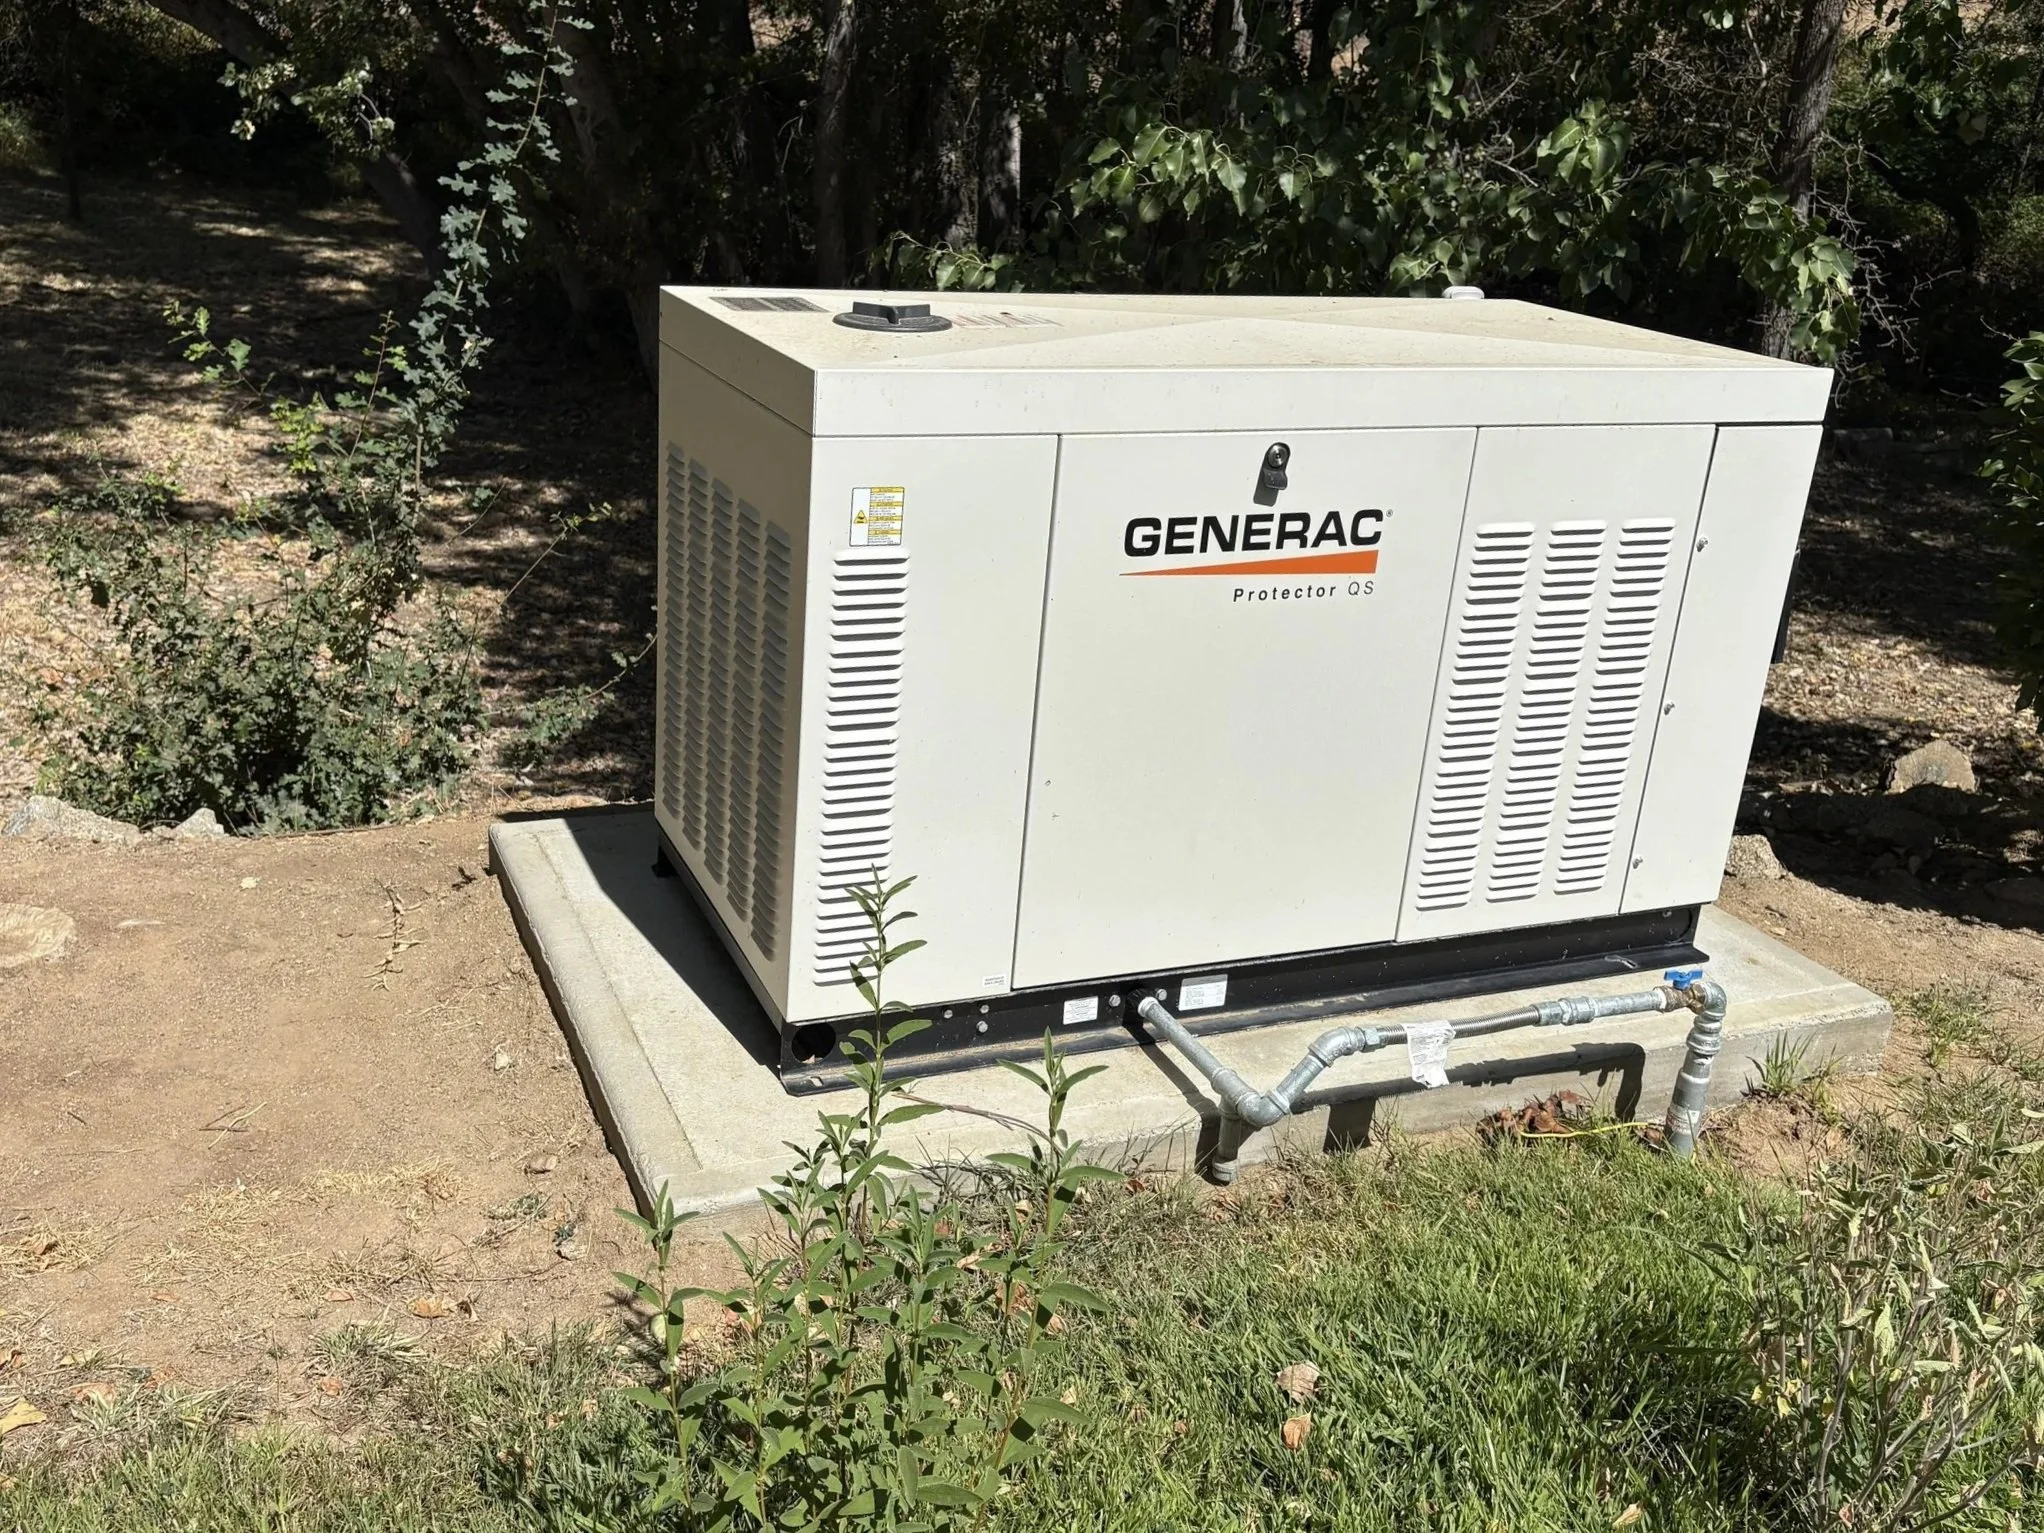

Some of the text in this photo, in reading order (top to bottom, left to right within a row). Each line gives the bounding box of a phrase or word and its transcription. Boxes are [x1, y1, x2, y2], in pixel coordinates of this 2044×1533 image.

[1124, 509, 1384, 557] GENERAC
[1232, 580, 1375, 602] Protector QS
